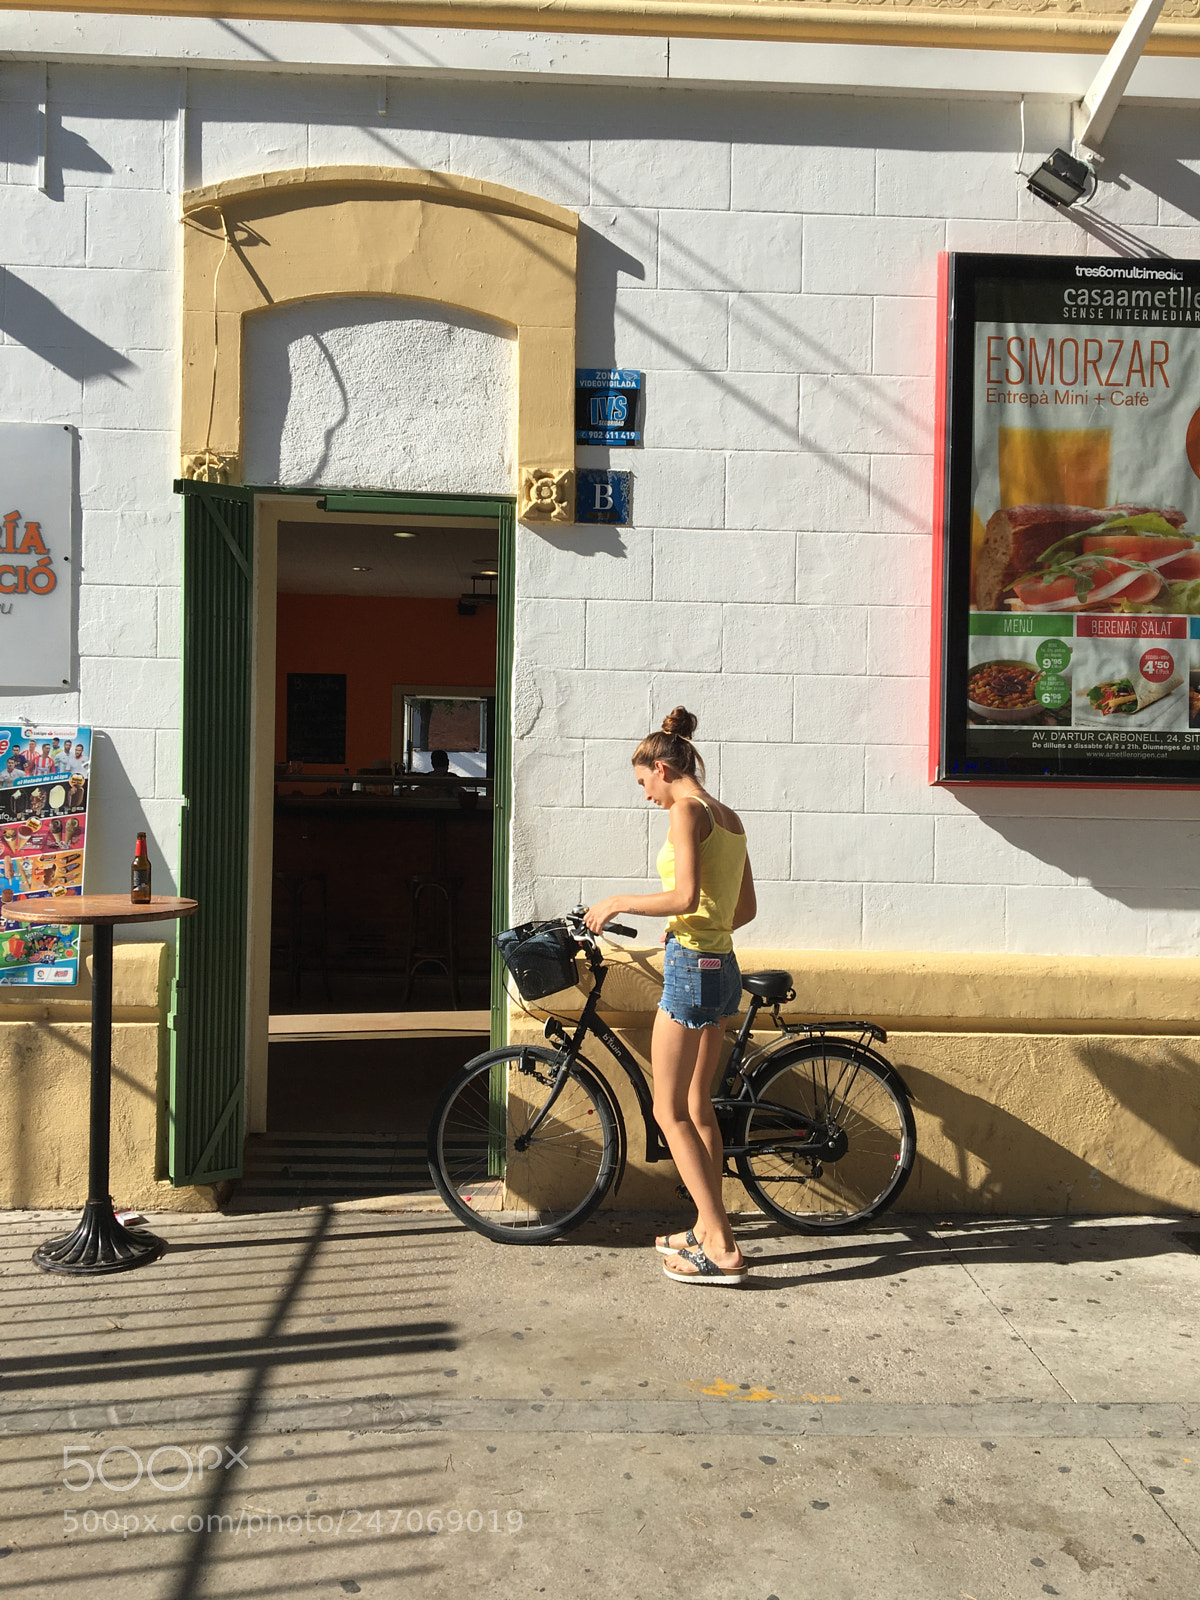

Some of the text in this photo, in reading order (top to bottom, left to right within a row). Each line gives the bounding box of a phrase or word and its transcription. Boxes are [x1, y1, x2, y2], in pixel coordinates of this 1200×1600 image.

[1063, 307, 1104, 319] SENSE
[986, 336, 1170, 388] ESMORZAR
[579, 379, 637, 388] VIDEOVIGILADA
[595, 371, 621, 380] ZONA
[986, 387, 1049, 408] Entrepà
[1054, 390, 1088, 405] Mini
[1094, 394, 1106, 405] +
[590, 395, 628, 425] IVS
[588, 431, 636, 440] 902 611 419
[592, 483, 614, 510] B
[0, 510, 49, 554] ÍA
[1003, 616, 1033, 633] MENÚ
[1091, 620, 1173, 636] BERENAR SALAT
[1032, 731, 1047, 741] AV.
[1050, 731, 1095, 741] D'ARTUR
[1097, 732, 1163, 743] CARBONELL,
[1166, 734, 1181, 743] 24.
